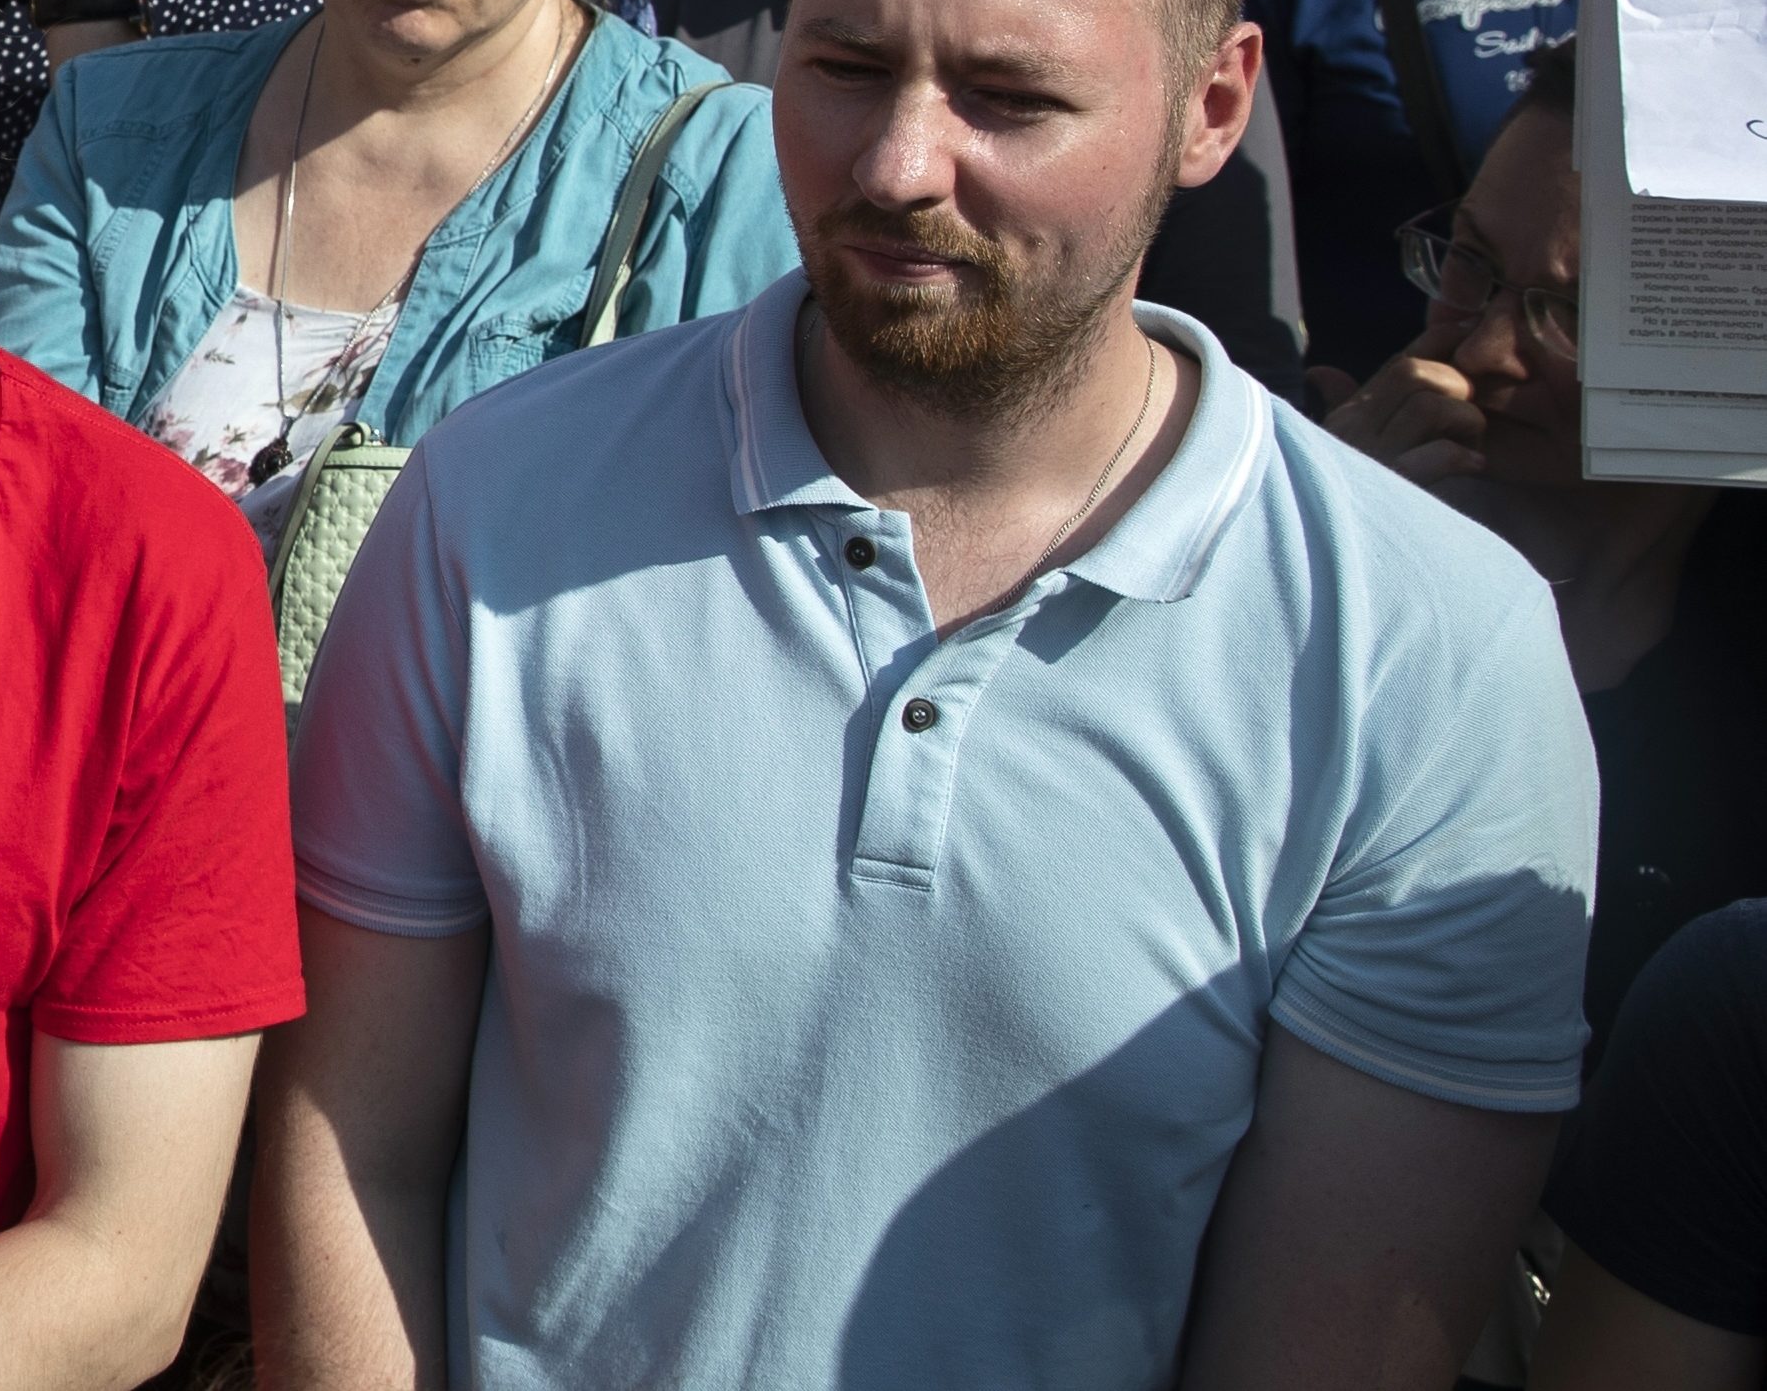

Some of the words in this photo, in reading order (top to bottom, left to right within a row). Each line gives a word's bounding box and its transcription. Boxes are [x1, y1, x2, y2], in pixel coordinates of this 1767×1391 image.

[1659, 248, 1698, 258] Власть
[1702, 250, 1764, 260] собралась
[1630, 272, 1711, 282] транспортного.
[1681, 308, 1759, 318] современного
[1629, 329, 1666, 337] ездить
